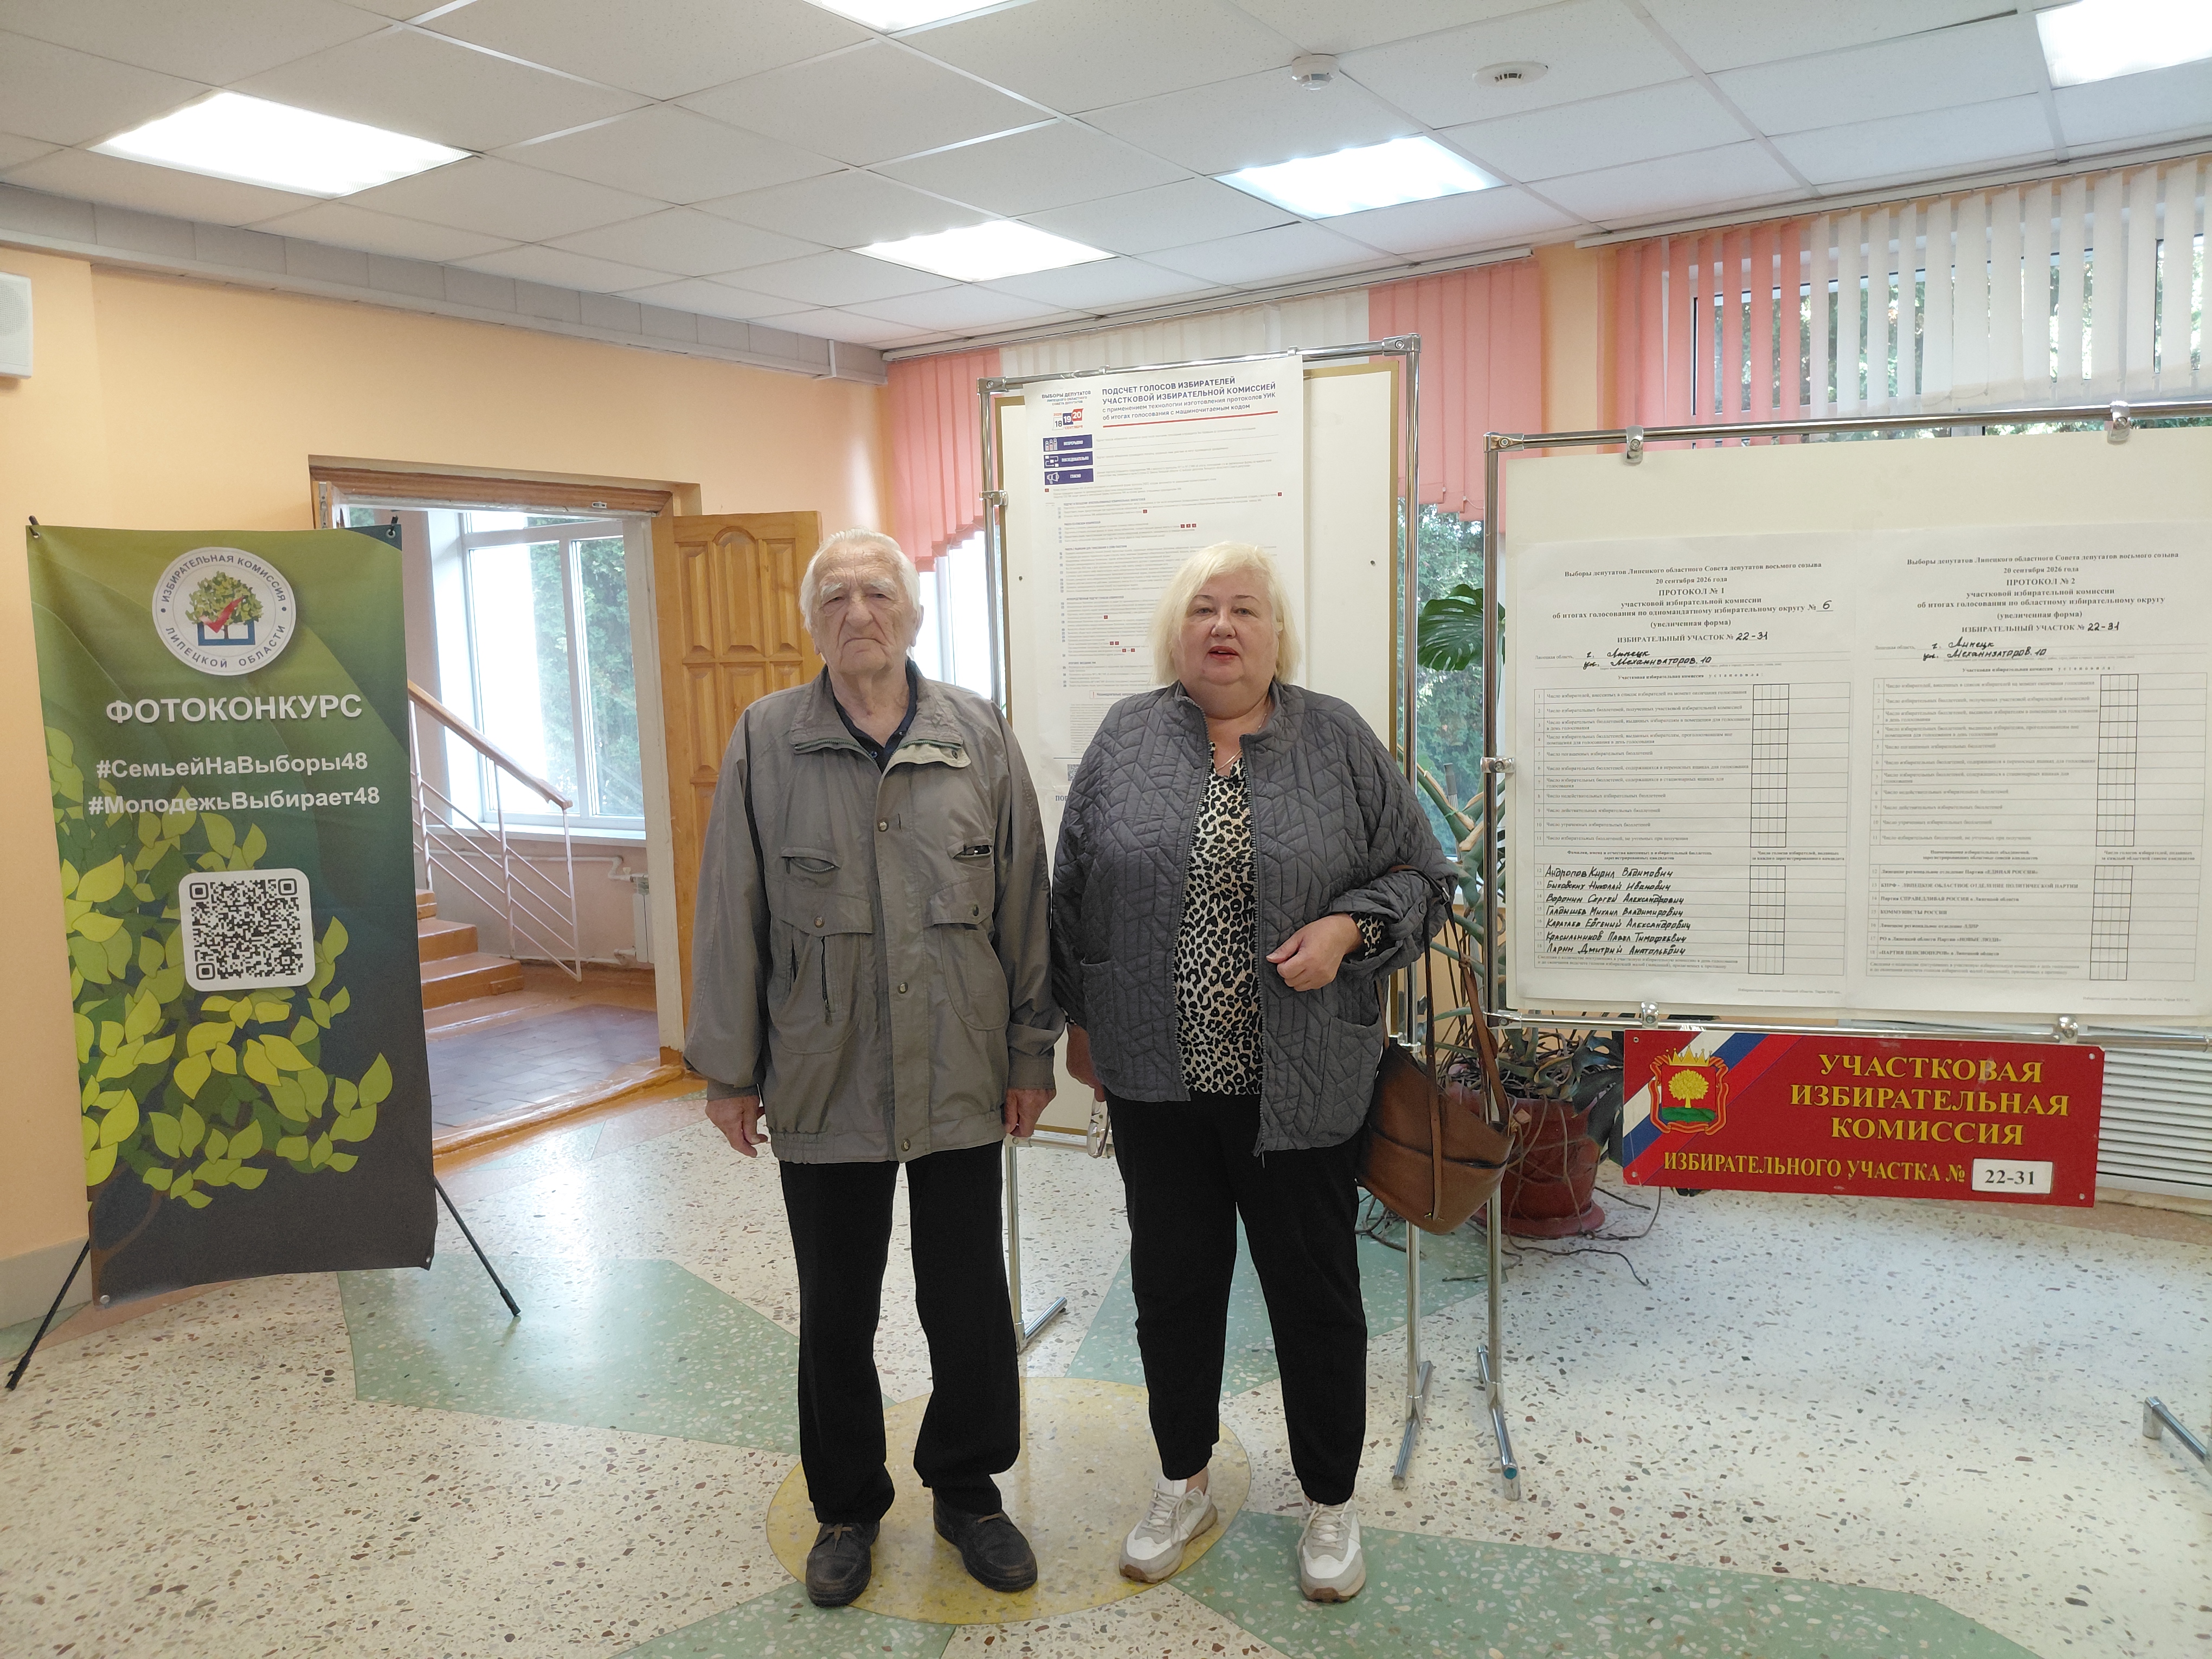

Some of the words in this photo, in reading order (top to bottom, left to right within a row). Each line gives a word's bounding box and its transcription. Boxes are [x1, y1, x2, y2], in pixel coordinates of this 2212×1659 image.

[1102, 386, 1137, 395] ПОДСЧЕТ
[1140, 383, 1176, 392] ГОЛОСОВ
[1178, 376, 1235, 389] ИЗБИРАТЕЛЕЙ
[1102, 393, 1154, 404] УЧАСТКОВОЙ
[1156, 387, 1224, 400] ИЗБИРАТЕЛЬНОЙ
[1227, 382, 1276, 394] КОМИССИЕЙ
[1107, 405, 1147, 413] применением
[1227, 395, 1262, 403] протоколов
[163, 554, 235, 603] ИЗБИРАТЕЛЬНАЯ
[237, 557, 287, 602] КОМИССИЯ
[1966, 590, 2011, 599] участковой
[1621, 600, 1663, 609] участковой
[1667, 598, 1722, 607] избирательной
[1823, 600, 1832, 609] 6
[2054, 611, 2082, 619] форма)
[1704, 619, 1731, 627] форма)
[2087, 621, 2119, 631] 22-31
[1618, 634, 1684, 642] ИЗБИРАТЕЛЬНЫЙ
[1735, 631, 1768, 641] 22-31
[1949, 636, 1995, 650] Липецк
[165, 626, 228, 668] ЛИПЕЦКОЙ
[239, 625, 286, 667] ОБЛАСТИ
[1607, 648, 1650, 657] Липецк
[106, 694, 363, 724] ФОТОКОНКУРС
[96, 753, 369, 779] #СемьейНаВыборы48
[88, 787, 381, 815] #МолодежьВыбирает48
[1545, 865, 1587, 880] Андропов
[1547, 880, 1585, 890] Быковских
[1589, 881, 1622, 890] Николай
[1627, 880, 1671, 891] Иванович
[1546, 893, 1583, 905] Воронин
[1588, 893, 1618, 903] Сергей
[1623, 893, 1684, 906] Александрович
[1546, 905, 1586, 915] Гладышев
[1590, 906, 1618, 916] Михаил
[1622, 906, 1683, 918] Владимирович
[1546, 918, 1581, 928] Каратаев
[1585, 918, 1622, 928] Евгений
[1626, 918, 1691, 930] Александрович
[1546, 930, 1604, 943] Красильников
[1607, 932, 1630, 942] Павел
[1635, 932, 1687, 944] Тимофеевич
[1547, 943, 1574, 954] Ларин
[1578, 943, 1622, 956] Дмитрий
[1629, 944, 1686, 955] Анатольевич
[1819, 1053, 2043, 1083] УЧАСТКОВАЯ
[1790, 1084, 2070, 1116] ИЗБИРАТЕЛЬНАЯ
[1831, 1117, 2023, 1146] КОМИССИЯ
[1664, 1152, 1842, 1178] ИЗБИРАТЕЛЬНОГО
[1847, 1160, 1939, 1182] УЧАСТКА
[1945, 1163, 1965, 1183] №
[1984, 1168, 2036, 1186] 22-31
